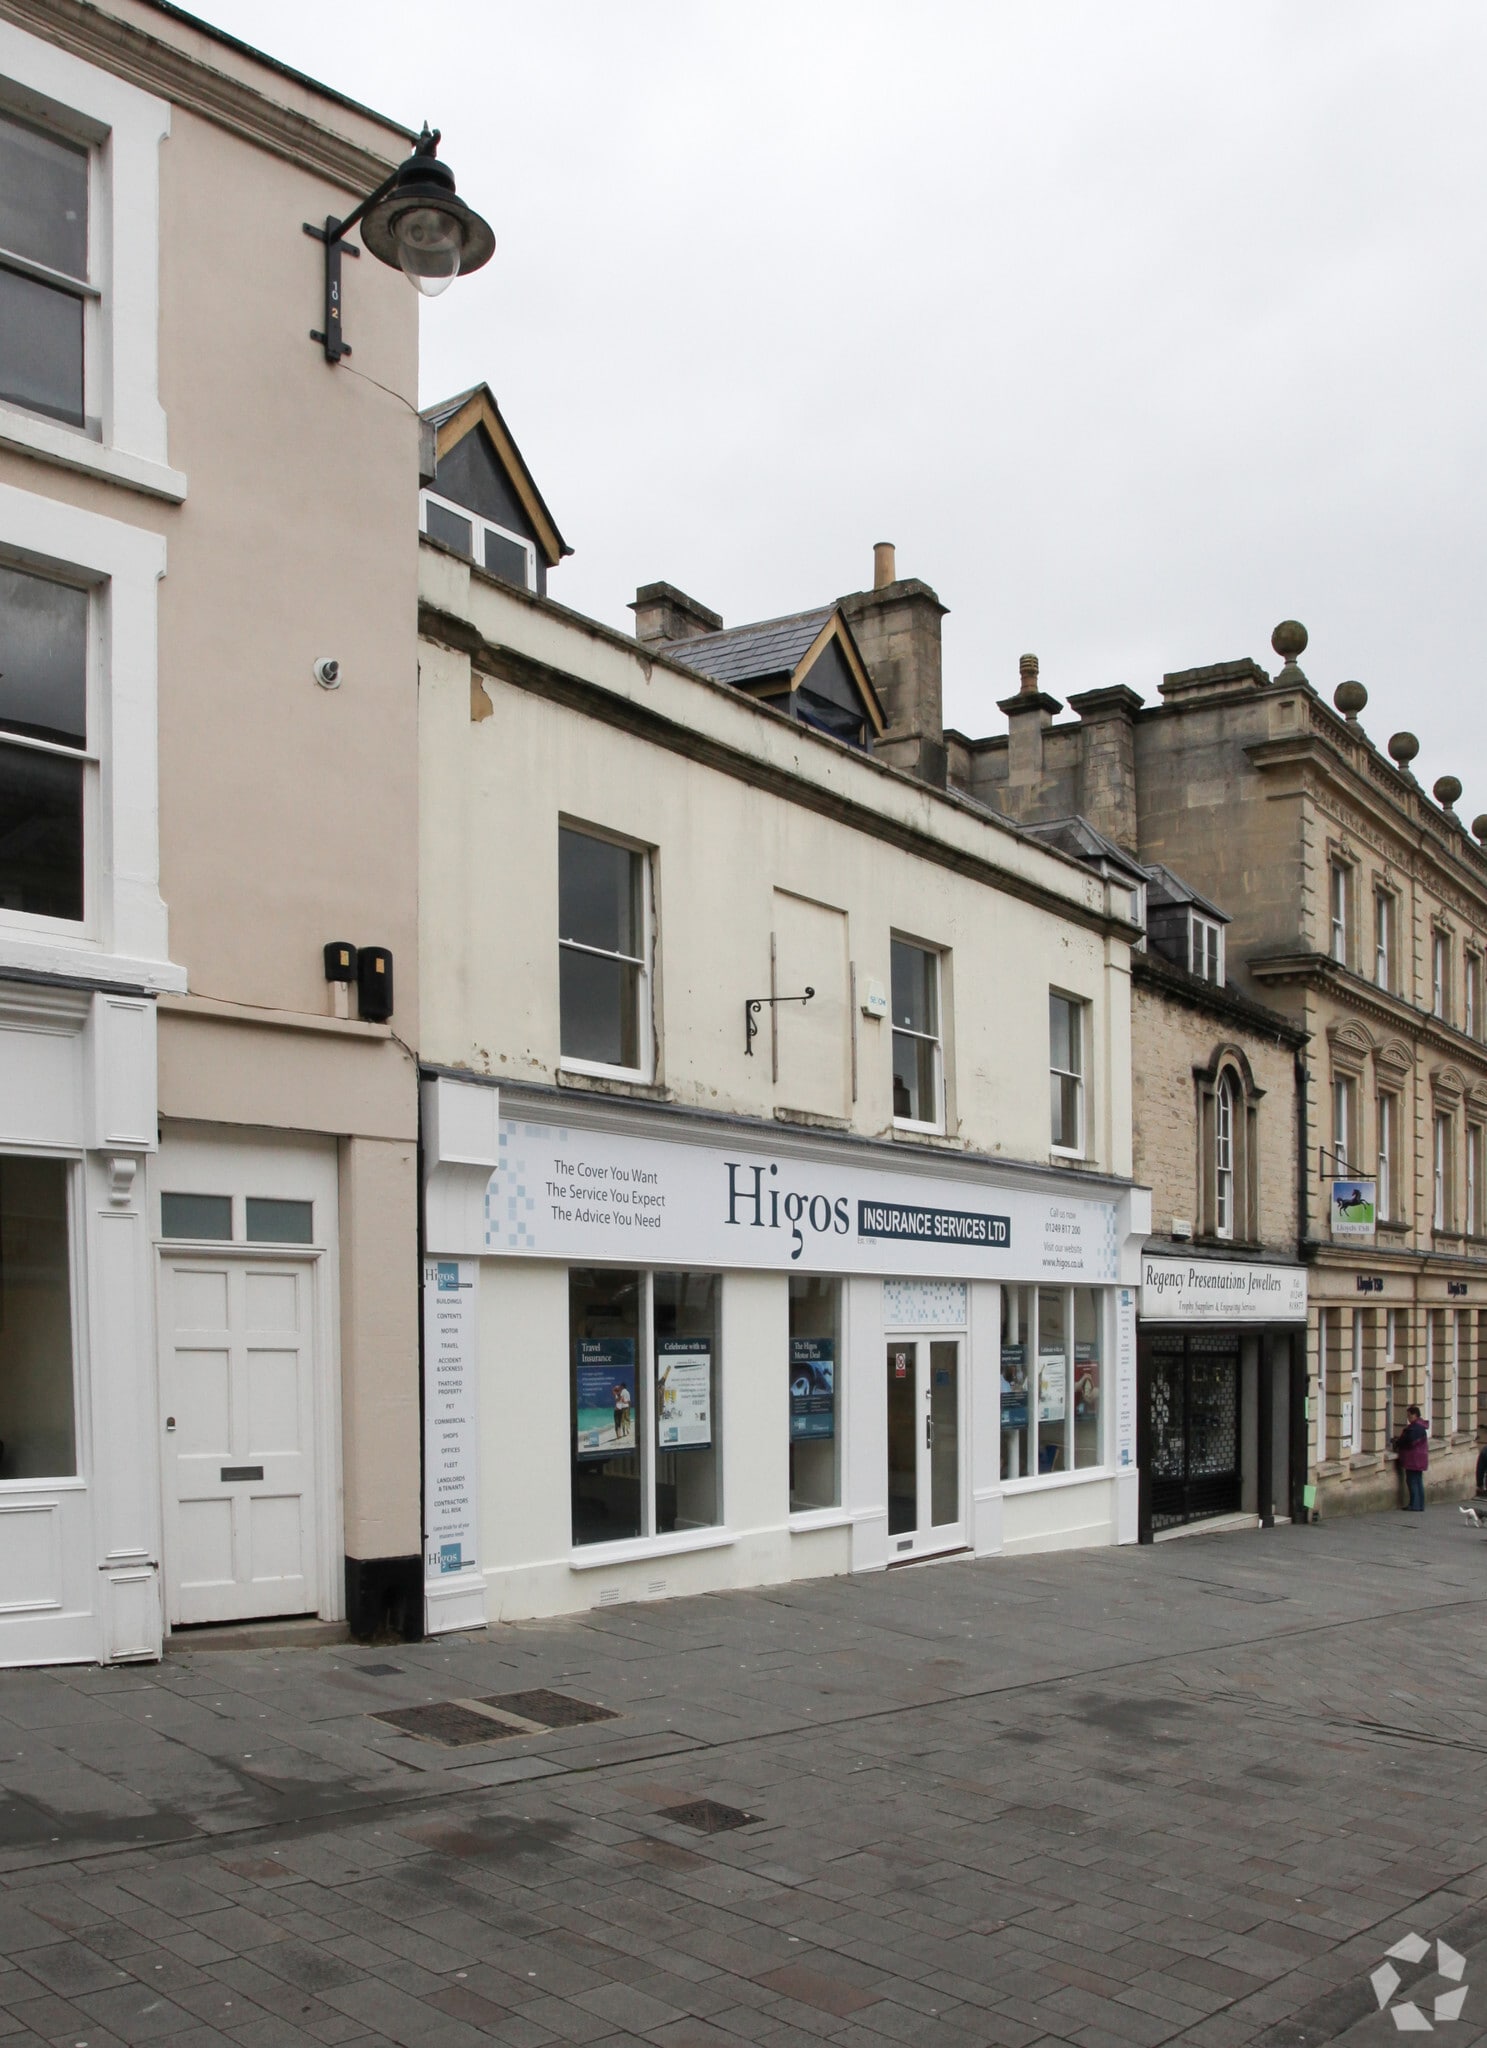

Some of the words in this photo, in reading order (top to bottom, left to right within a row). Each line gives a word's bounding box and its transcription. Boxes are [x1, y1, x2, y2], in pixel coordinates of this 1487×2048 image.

[554, 1159, 575, 1175] The
[577, 1162, 608, 1178] Cover
[610, 1166, 630, 1181] You
[631, 1168, 658, 1184] Want
[545, 1182, 567, 1197] The
[569, 1184, 608, 1201] Service
[610, 1188, 629, 1203] You
[632, 1191, 666, 1208] Expect
[551, 1205, 572, 1221] The
[575, 1208, 610, 1224] Advice
[613, 1211, 632, 1226] You
[634, 1213, 661, 1228] Need
[724, 1162, 850, 1260] Higos
[1050, 1207, 1059, 1218] Call
[1060, 1211, 1066, 1219] us
[863, 1206, 932, 1235] INSURANCE
[934, 1217, 986, 1241] SERVICES
[988, 1222, 1006, 1242] LTD
[1045, 1222, 1061, 1233] 01249
[1043, 1242, 1054, 1252] Visit
[1055, 1245, 1063, 1253] our
[1064, 1244, 1083, 1254] website
[1042, 1257, 1084, 1270] www.higos.co.uk
[425, 1268, 455, 1287] Higos
[1146, 1265, 1185, 1295] Regency
[1188, 1268, 1246, 1290] Presentations
[1247, 1271, 1281, 1295] Jewellers
[582, 1343, 600, 1352] Travel
[664, 1342, 688, 1351] Celebrate
[689, 1342, 698, 1350] with
[794, 1342, 803, 1350] The
[804, 1342, 818, 1351] Higos
[582, 1354, 612, 1363] Insurance
[794, 1351, 809, 1359] Motor
[810, 1351, 820, 1359] Deal
[437, 1475, 465, 1484] LANDLORDS
[434, 1497, 468, 1507] CONTRACTORS
[428, 1552, 457, 1569] Higos
